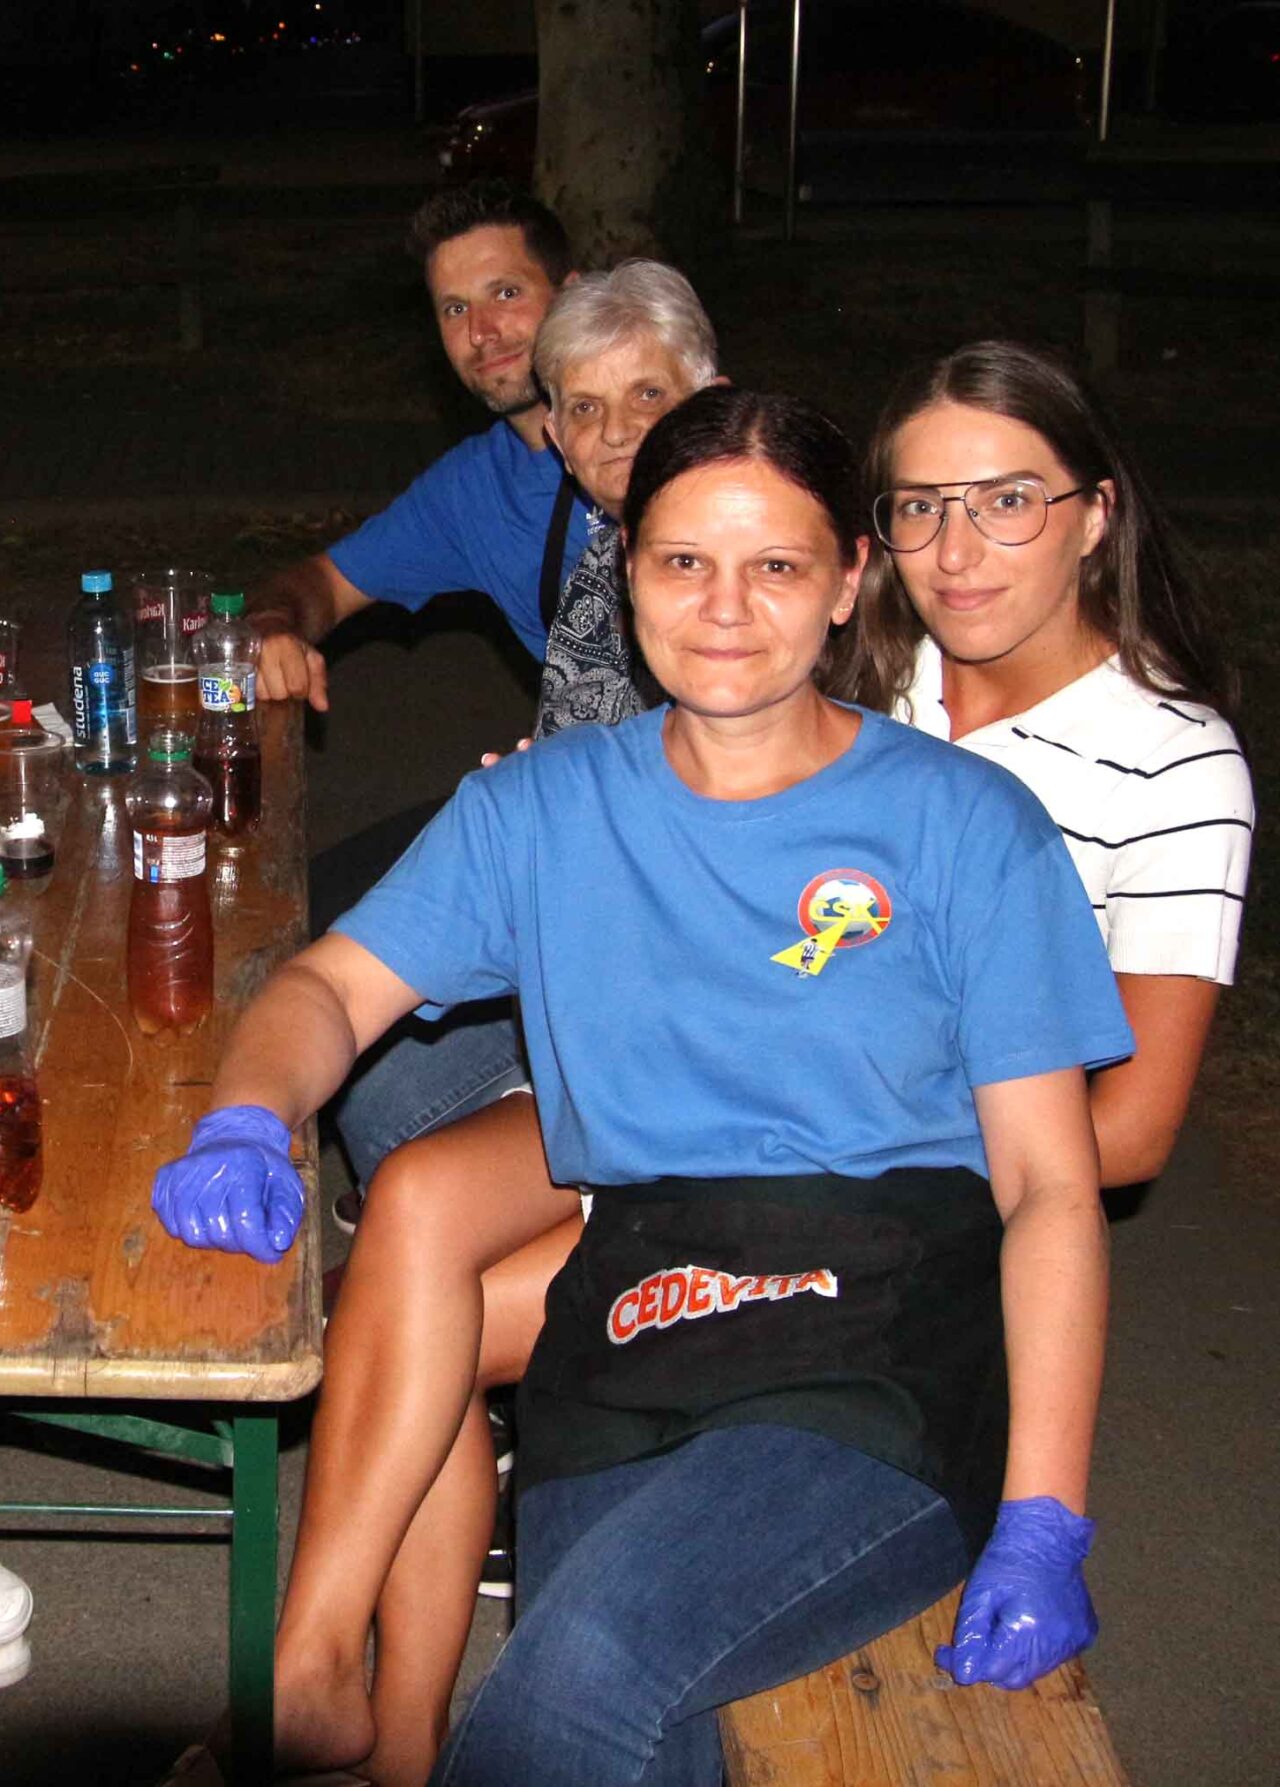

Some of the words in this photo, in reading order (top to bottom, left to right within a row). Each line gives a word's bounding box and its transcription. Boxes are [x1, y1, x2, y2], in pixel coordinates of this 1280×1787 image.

[73, 665, 86, 739] studena
[200, 678, 219, 690] ICE
[203, 692, 230, 704] TEA
[608, 1264, 837, 1342] CEDEVITA
